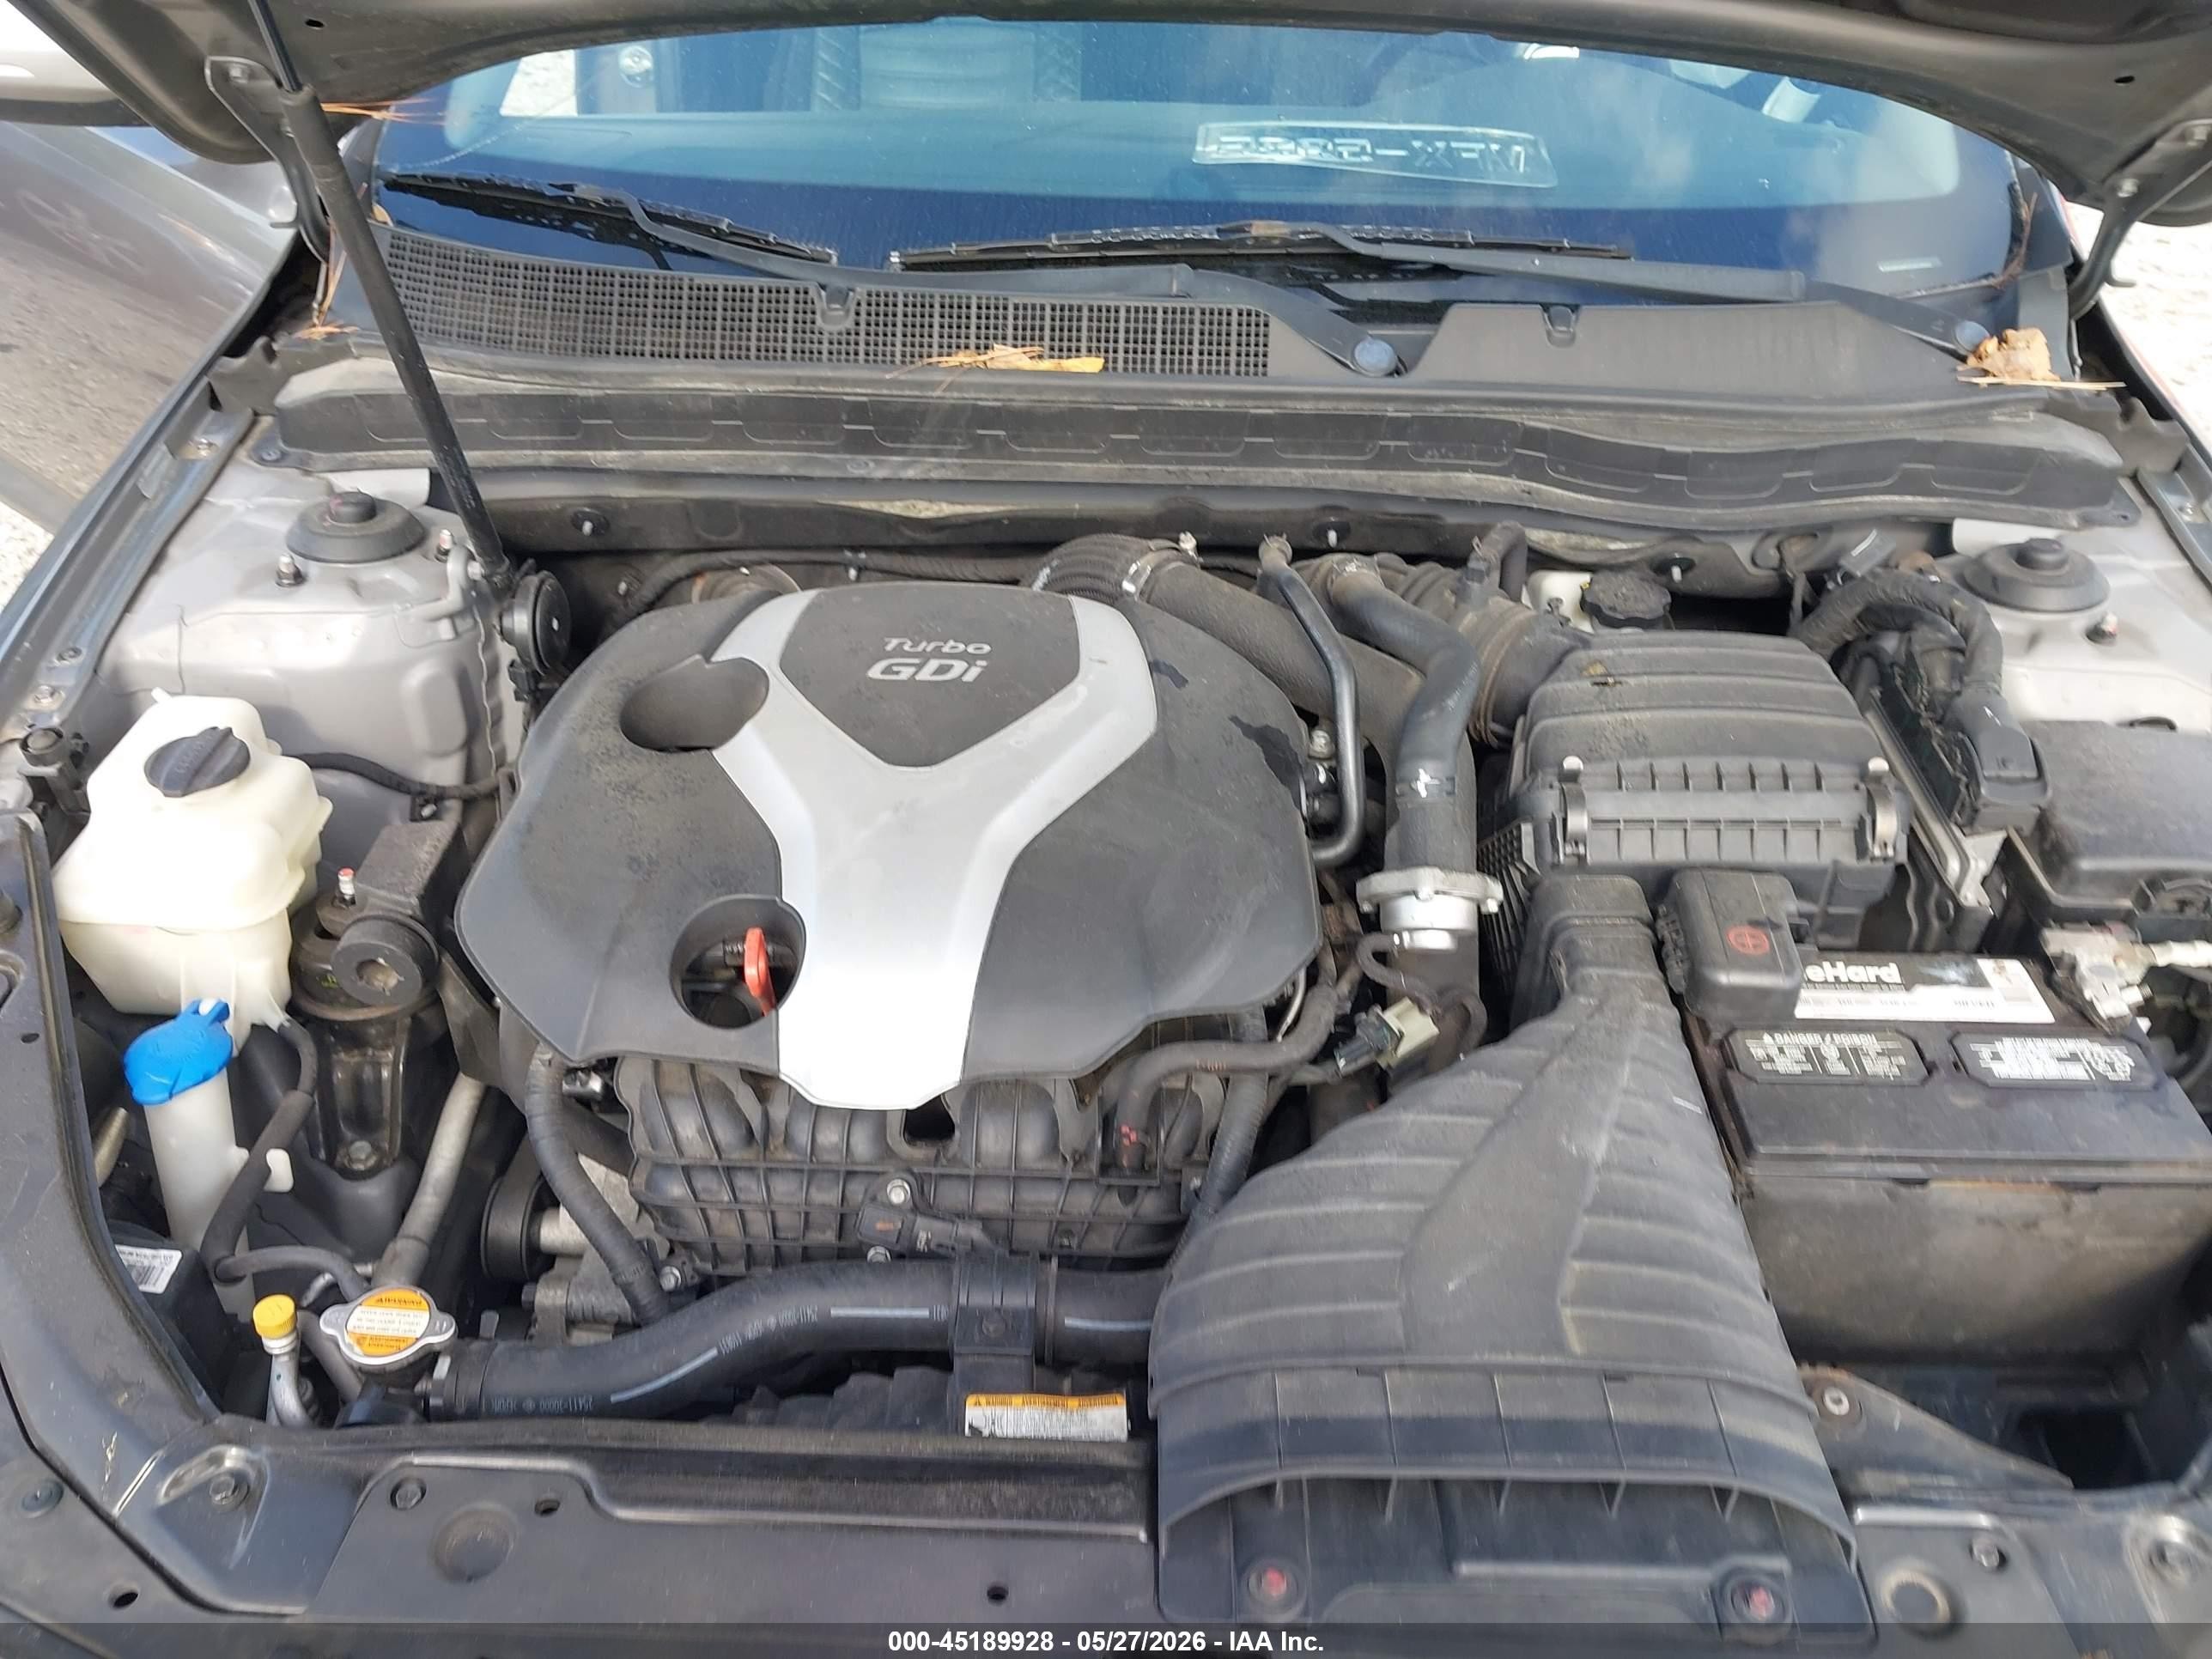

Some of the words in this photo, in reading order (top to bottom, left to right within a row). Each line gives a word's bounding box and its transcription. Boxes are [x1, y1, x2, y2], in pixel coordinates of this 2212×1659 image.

[884, 636, 992, 654] Turbo
[866, 657, 988, 683] GDi
[1804, 961, 1903, 984] eHard
